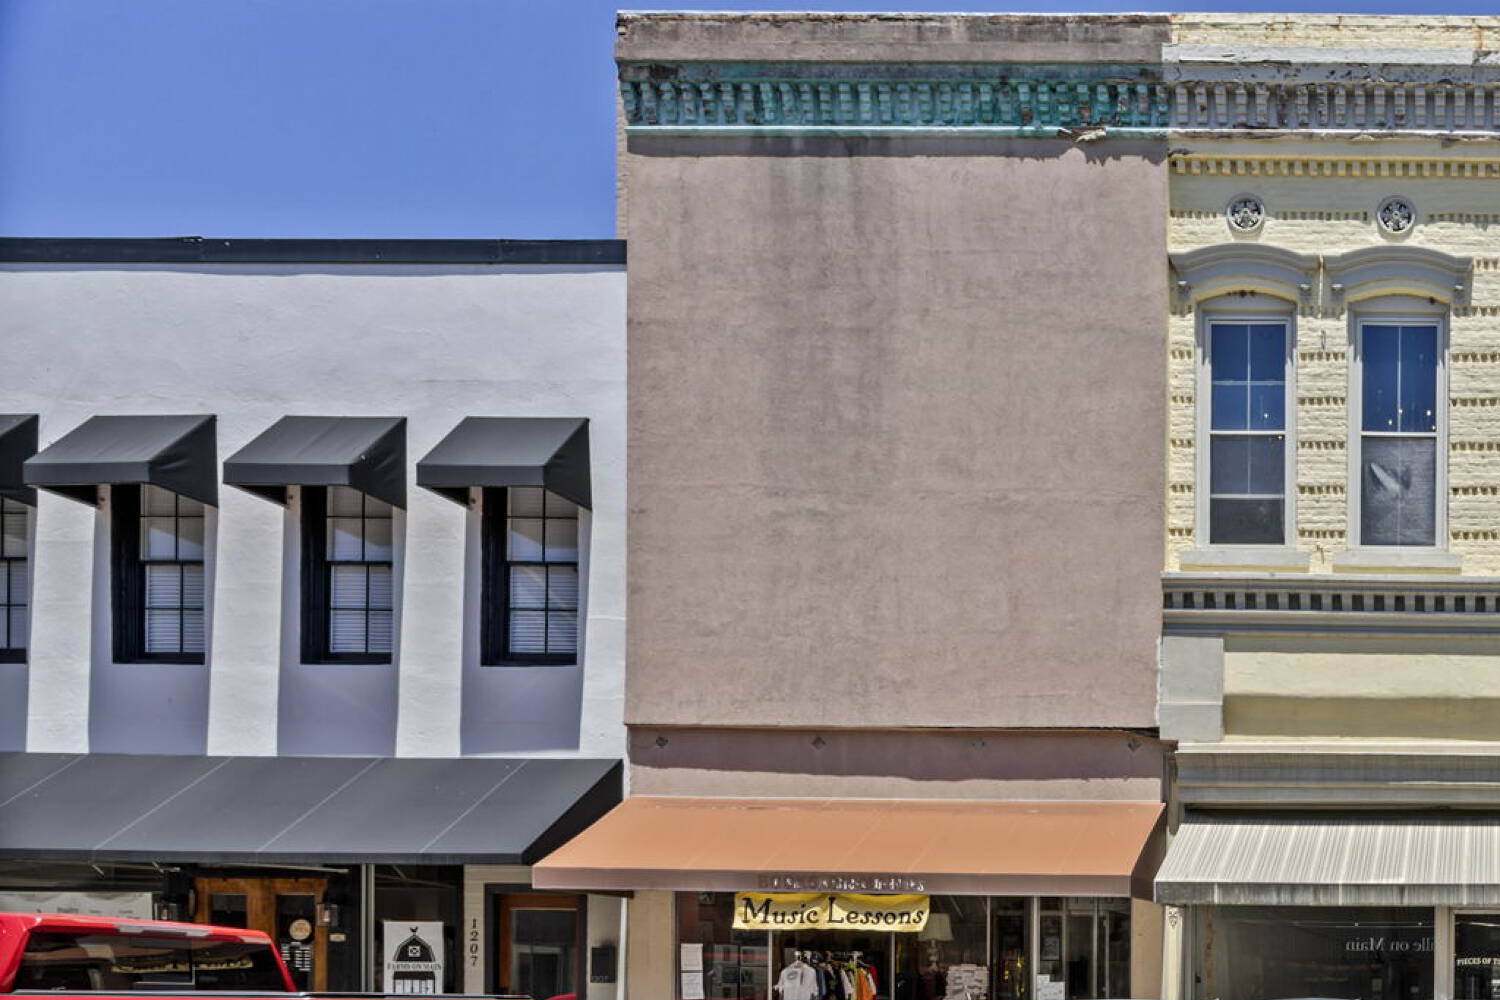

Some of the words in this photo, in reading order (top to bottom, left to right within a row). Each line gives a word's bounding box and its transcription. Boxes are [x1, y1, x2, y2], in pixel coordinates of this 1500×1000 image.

[741, 897, 820, 924] Music
[826, 896, 925, 925] Lessons
[469, 918, 479, 968] 1207
[1456, 957, 1482, 967] PIECES
[1482, 957, 1492, 965] OF
